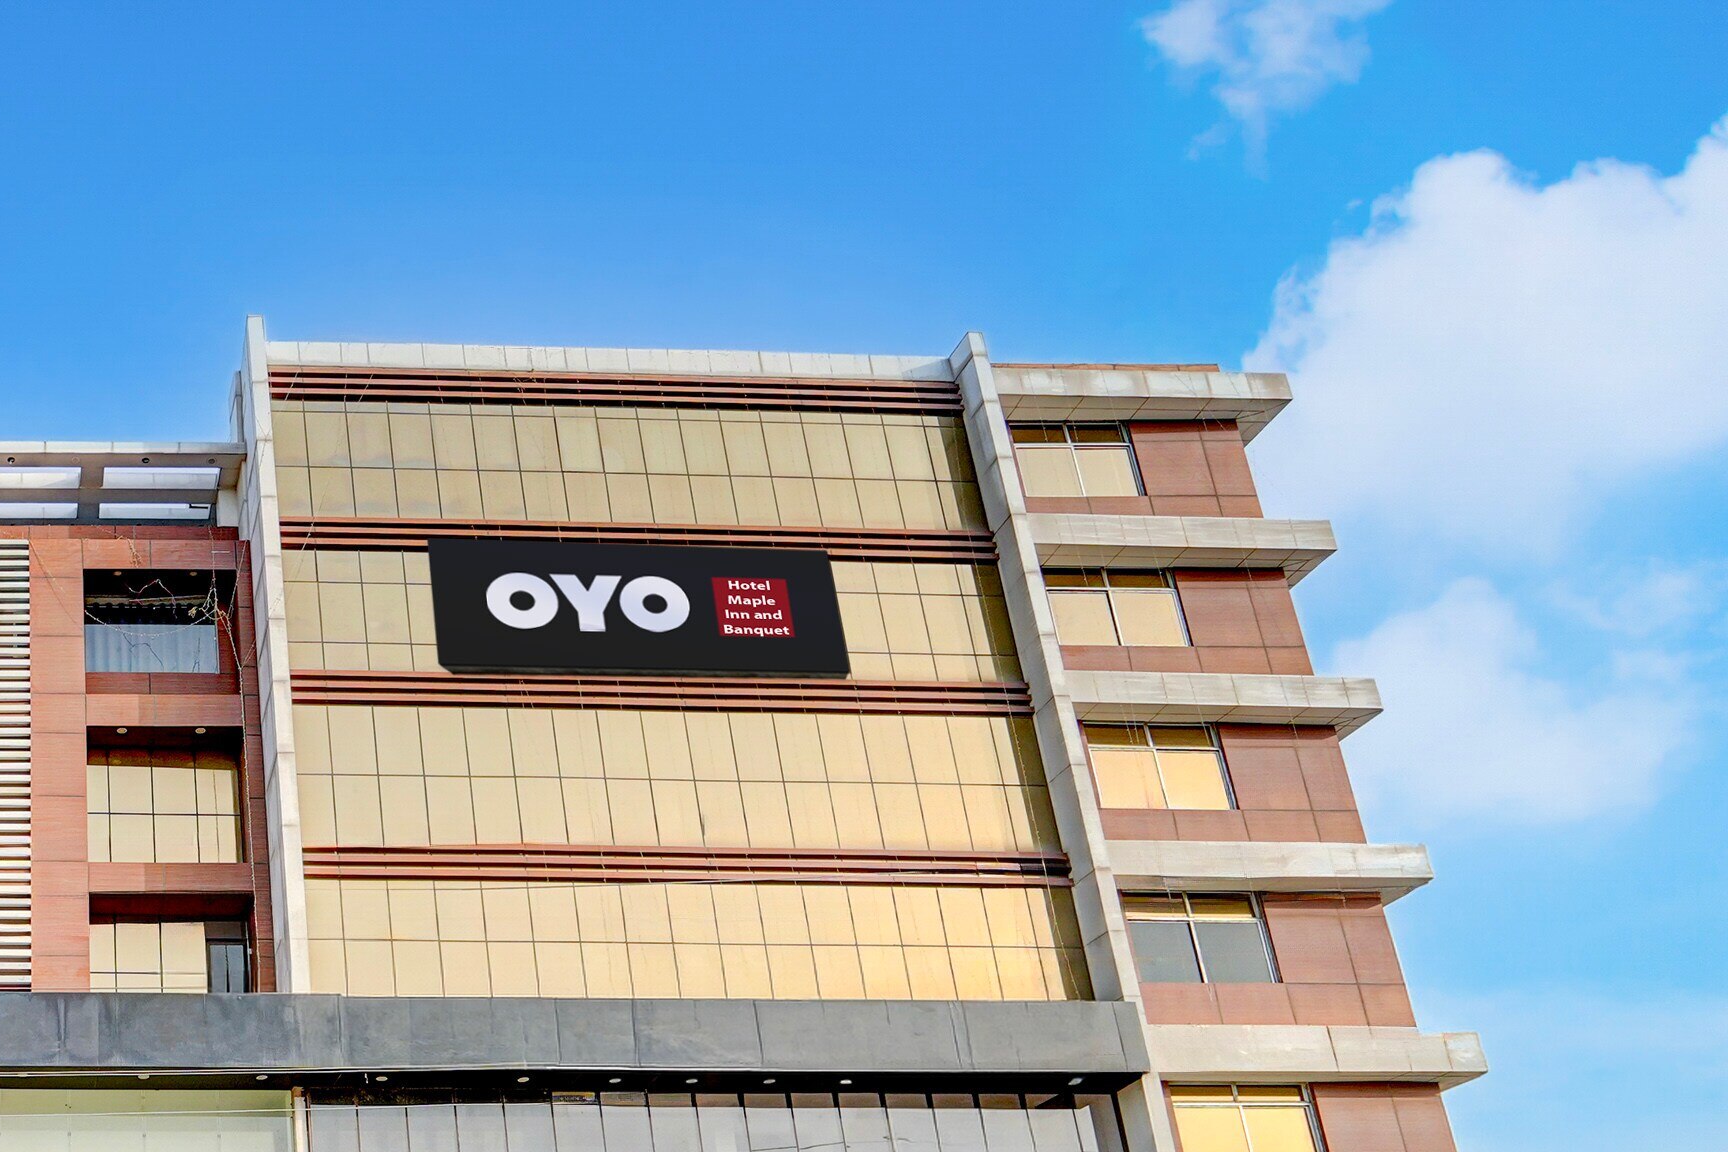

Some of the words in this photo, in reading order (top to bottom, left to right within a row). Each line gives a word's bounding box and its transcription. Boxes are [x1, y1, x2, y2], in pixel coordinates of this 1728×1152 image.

[727, 580, 771, 591] Hotel
[485, 571, 691, 633] OYO
[727, 594, 776, 608] Maple
[724, 609, 750, 619] Inn
[754, 609, 783, 620] and
[723, 624, 790, 637] Banquet
